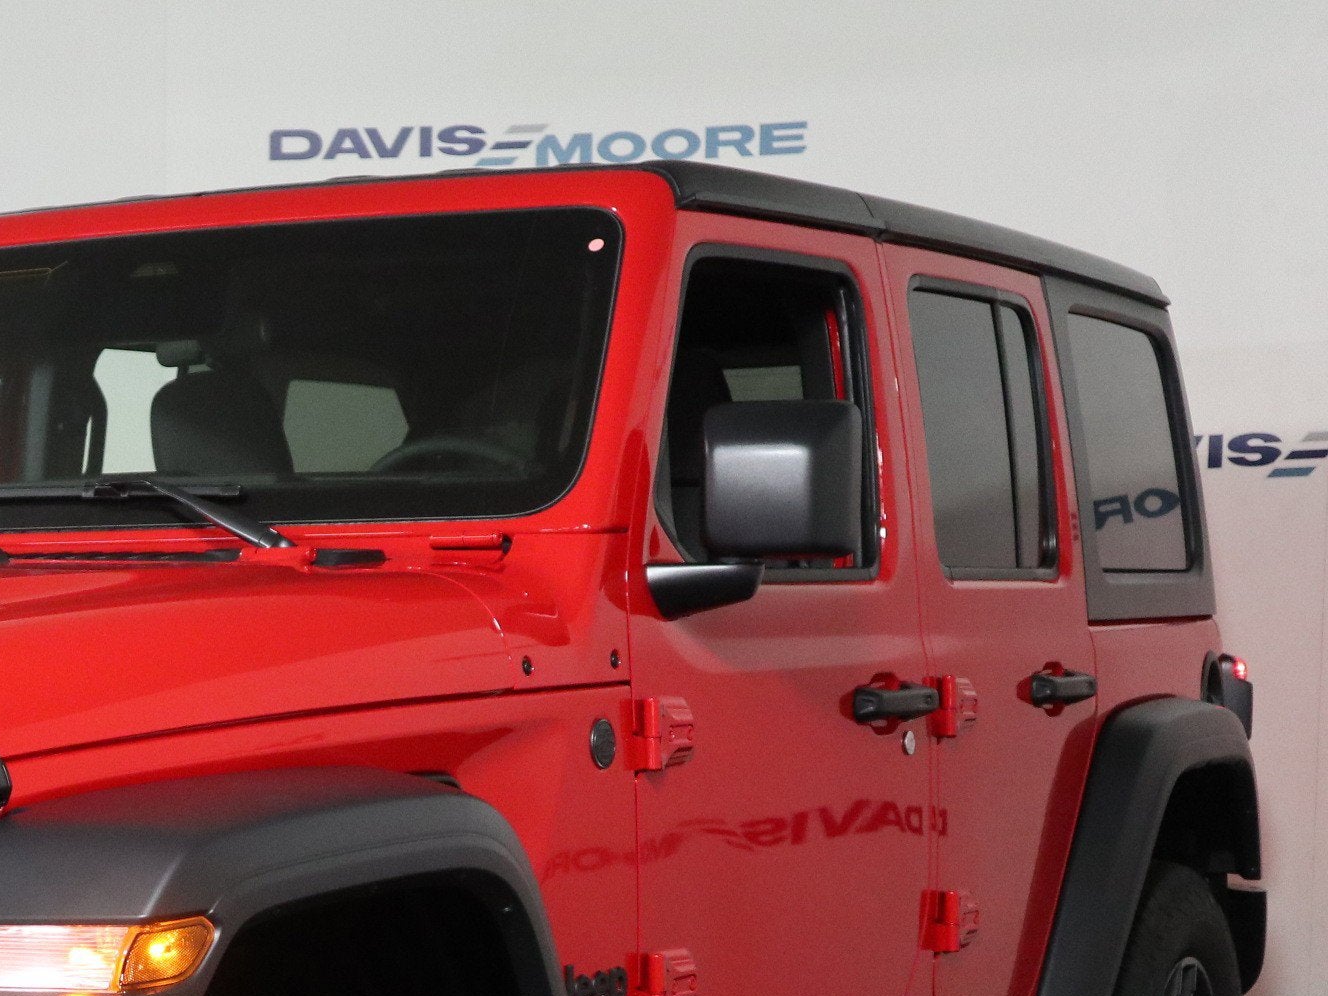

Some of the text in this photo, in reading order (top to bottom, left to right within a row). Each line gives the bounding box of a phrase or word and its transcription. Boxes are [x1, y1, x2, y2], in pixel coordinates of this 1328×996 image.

[268, 120, 808, 166] DAVIS MOORE
[1192, 432, 1283, 469] IS
